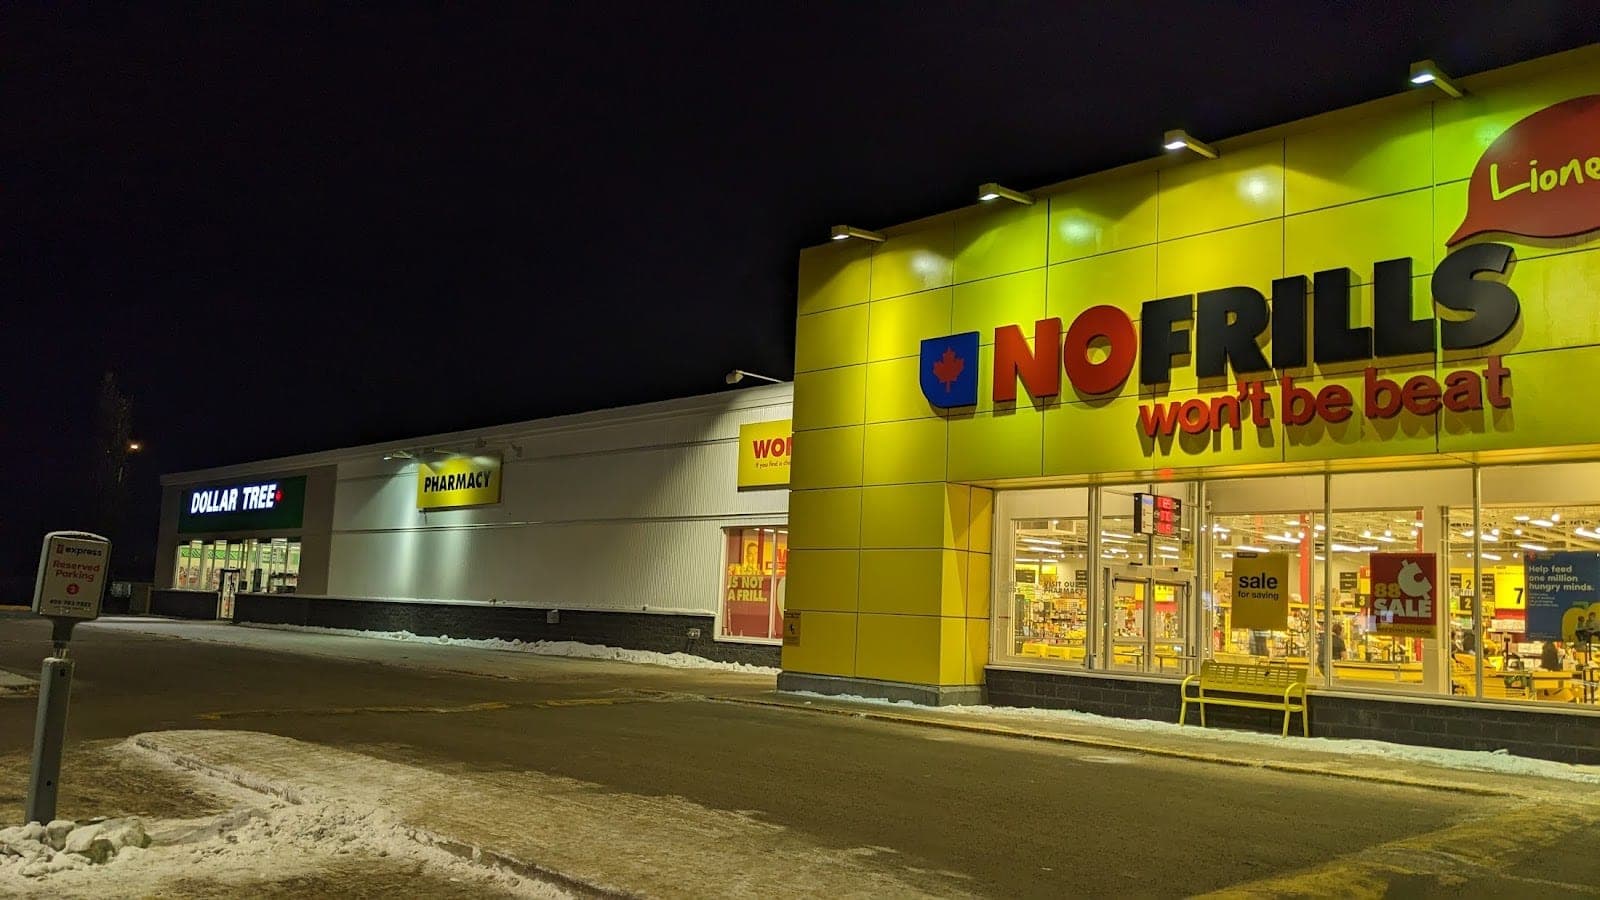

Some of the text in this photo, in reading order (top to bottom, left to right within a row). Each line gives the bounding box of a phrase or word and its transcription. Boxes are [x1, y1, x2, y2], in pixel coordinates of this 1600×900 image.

[1490, 157, 1600, 200] Lione
[1139, 356, 1511, 437] won't be beat
[424, 470, 492, 493] PHARMACY
[190, 484, 277, 514] DOLLAR TREE
[65, 547, 102, 556] express
[53, 561, 100, 572] Reserved
[1528, 564, 1573, 574] Help feed
[55, 570, 94, 583] Parking
[1239, 571, 1278, 589] sale
[1528, 574, 1578, 582] one million
[741, 576, 764, 589] NOT
[1465, 580, 1472, 589] 2
[1528, 582, 1561, 592] hungry
[728, 589, 736, 601] A
[1251, 591, 1279, 601] saving
[1359, 597, 1366, 606] 3
[1464, 598, 1472, 609] 2
[1374, 597, 1432, 618] SALE
